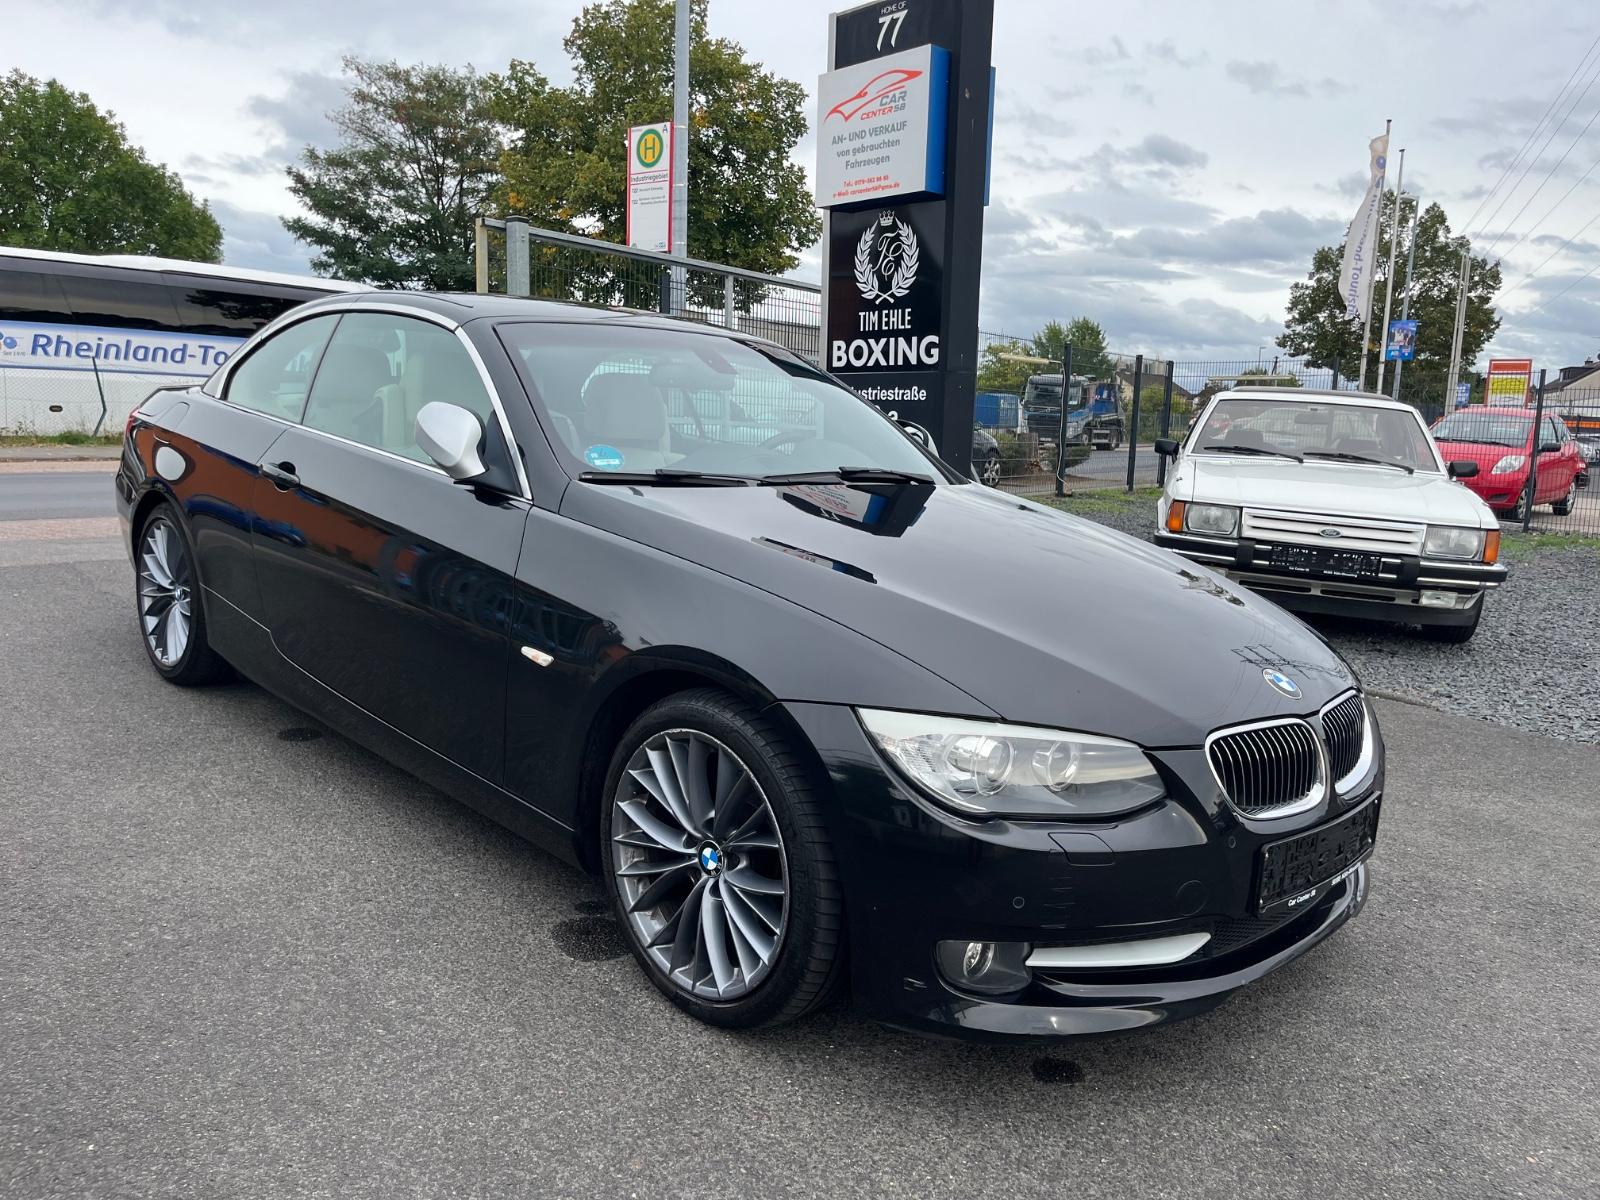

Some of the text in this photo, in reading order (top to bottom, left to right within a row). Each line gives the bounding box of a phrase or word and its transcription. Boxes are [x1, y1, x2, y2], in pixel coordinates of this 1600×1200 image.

[880, 1, 907, 15] HOME OF
[876, 9, 908, 52] 77
[879, 90, 907, 107] CAR
[860, 106, 893, 120] CENTER
[831, 120, 908, 145] AN- UND VERKAUF
[644, 137, 656, 160] H
[836, 138, 901, 158] von gebrauchten
[845, 155, 890, 170] Fahrzeugen
[630, 172, 669, 183] Industriegebiet
[858, 308, 912, 332] TIM EHLE
[831, 335, 940, 368] BOXING
